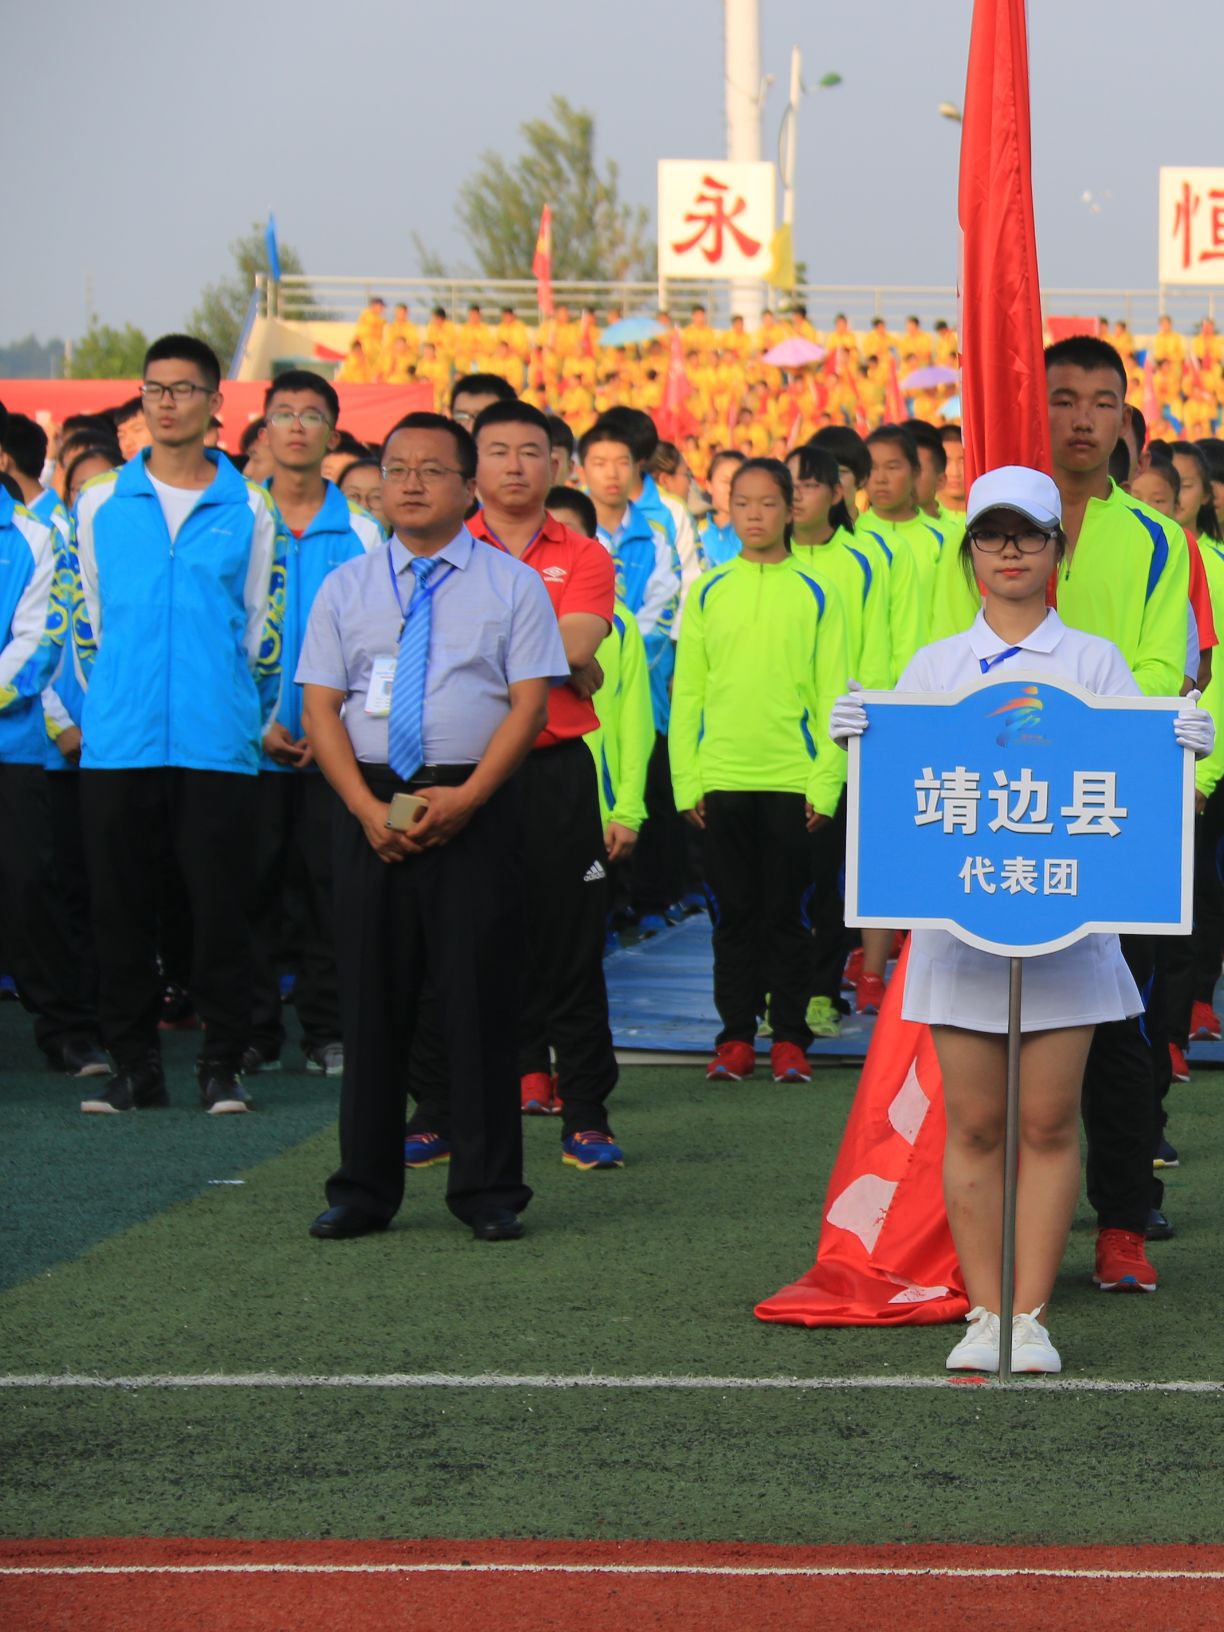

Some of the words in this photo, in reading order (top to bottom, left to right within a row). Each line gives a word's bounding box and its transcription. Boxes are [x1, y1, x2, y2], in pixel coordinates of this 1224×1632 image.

[672, 172, 762, 266] 永
[914, 766, 1128, 837] 靖边县
[958, 856, 1079, 896] 代表团
